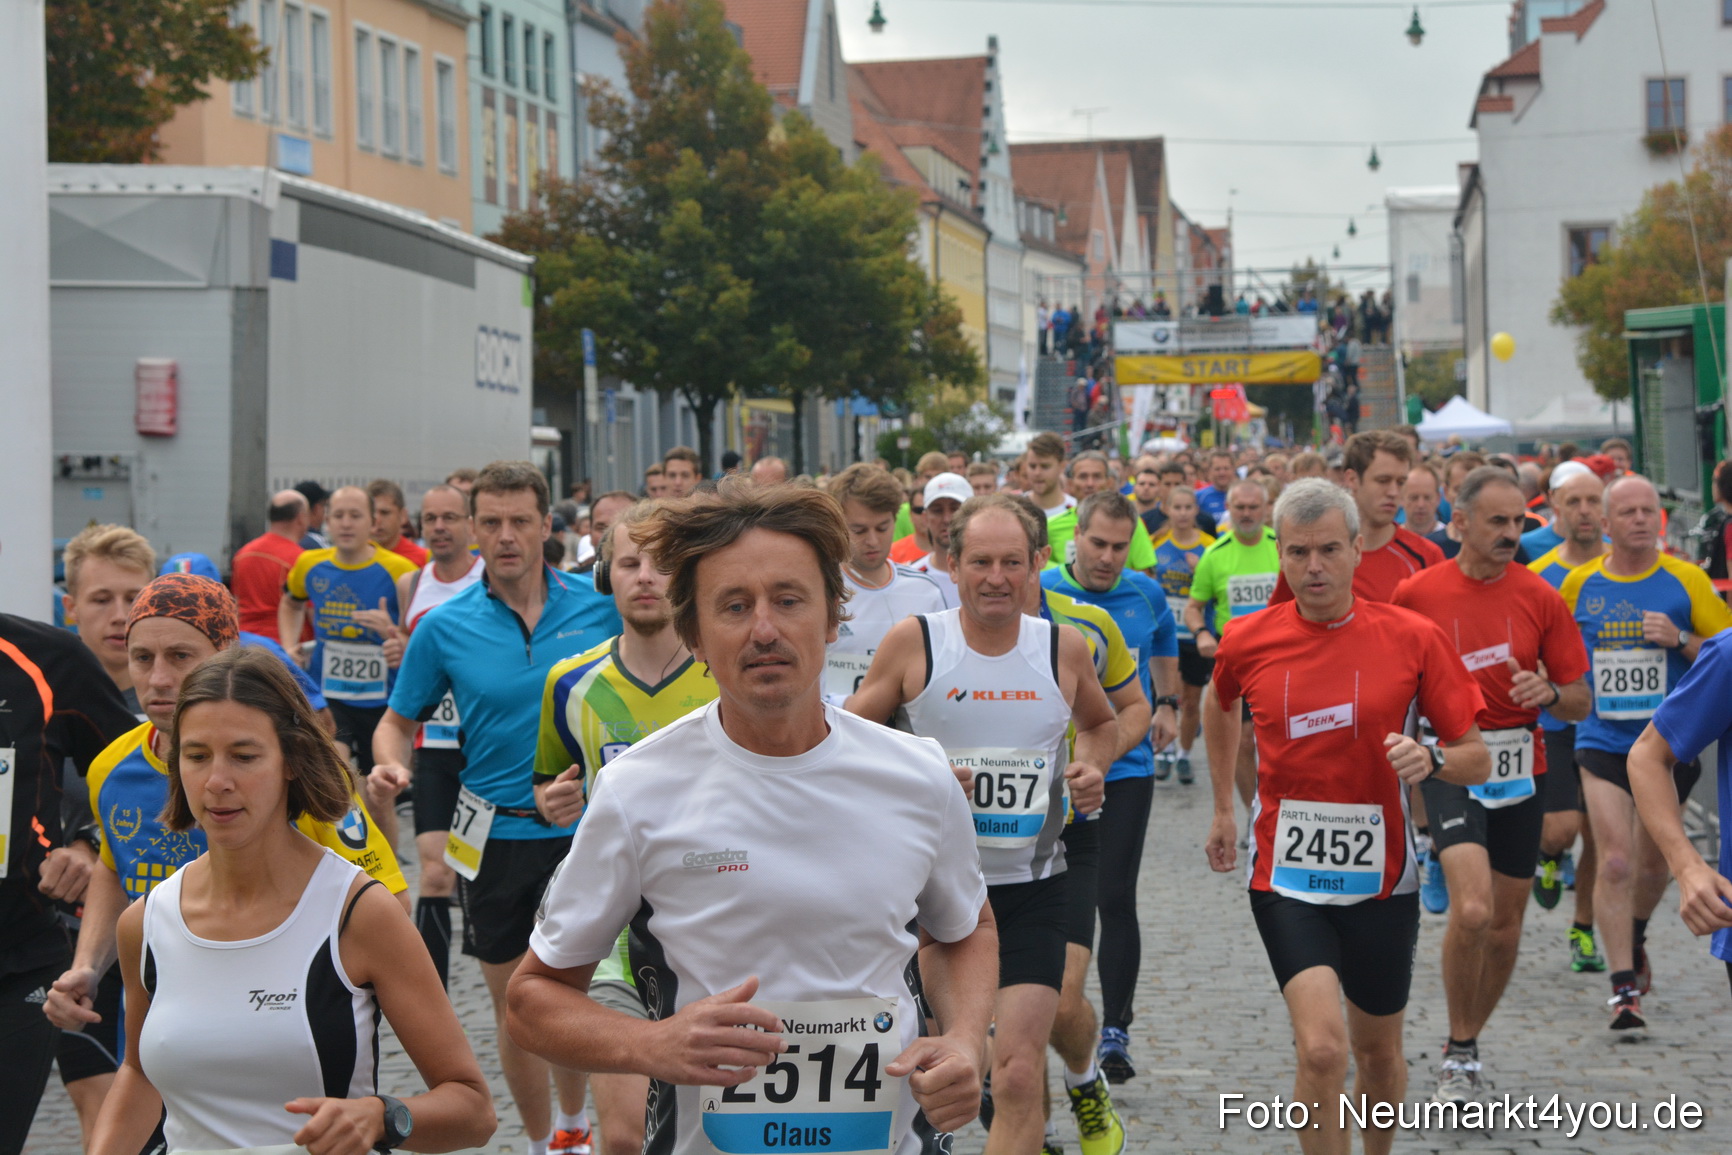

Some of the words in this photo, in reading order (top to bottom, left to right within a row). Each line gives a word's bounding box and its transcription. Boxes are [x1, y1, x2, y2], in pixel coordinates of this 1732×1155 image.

[1182, 358, 1251, 377] START
[1233, 584, 1273, 603] 3308
[330, 656, 381, 679] 2820
[828, 660, 857, 670] PARTL
[1601, 667, 1659, 692] 2898
[973, 691, 1043, 700] KLEBL
[1307, 714, 1335, 728] DEHN
[950, 758, 977, 767] ARTL
[980, 757, 1030, 768] Neumarkt
[1497, 747, 1523, 777] 81
[974, 772, 1039, 809] 057
[122, 809, 131, 817] 15
[1281, 810, 1311, 822] PARTL
[1314, 812, 1365, 824] Neumarkt
[115, 819, 134, 829] Jahre
[1285, 826, 1374, 866] 2452
[717, 863, 749, 873] PRO
[1308, 874, 1345, 891] Ernst
[249, 989, 298, 1011] Tyron
[781, 1017, 867, 1035] Neumarkt
[706, 1100, 715, 1111] A
[763, 1121, 832, 1147] Claus
